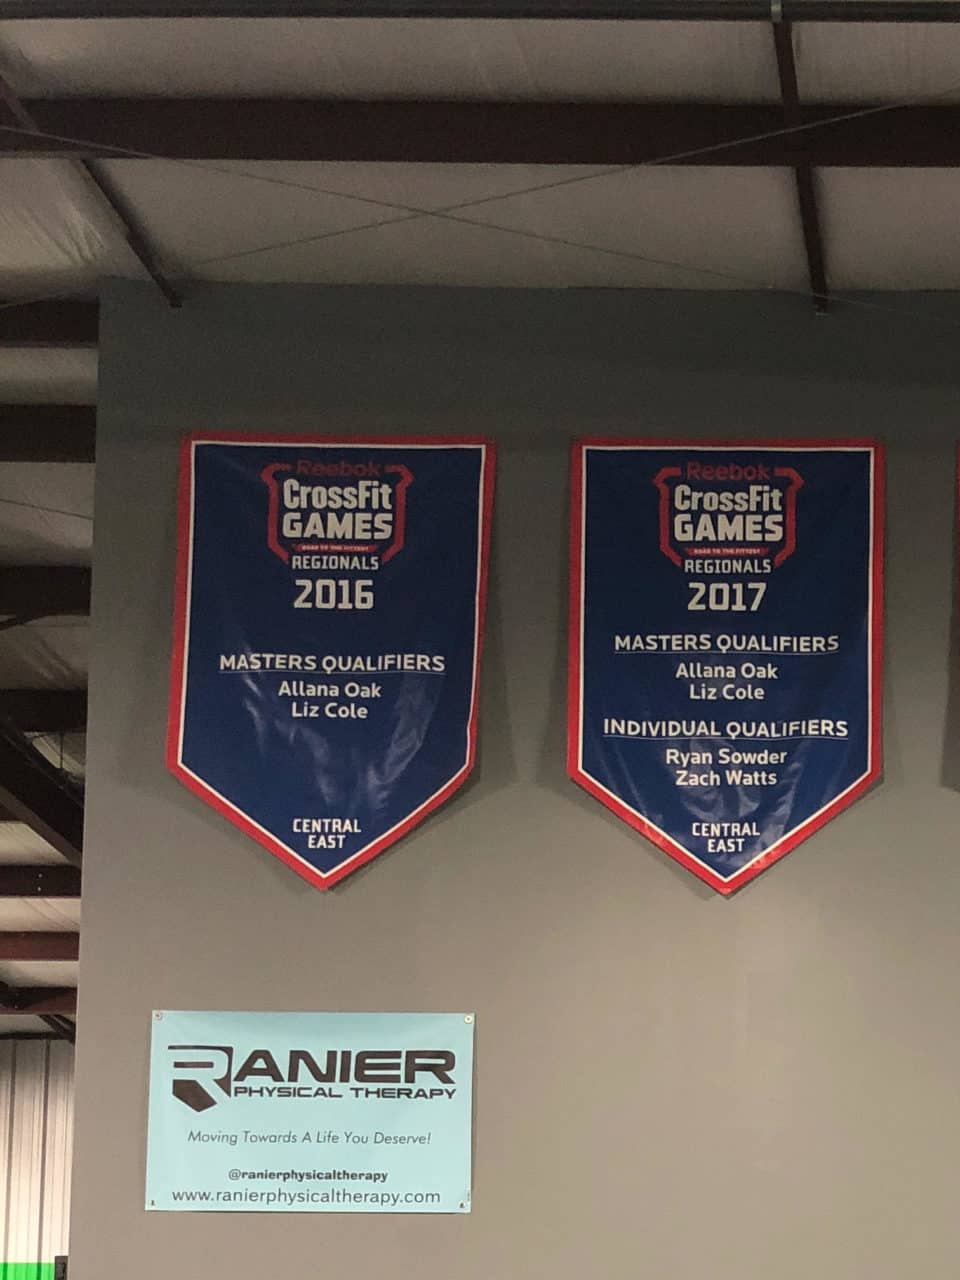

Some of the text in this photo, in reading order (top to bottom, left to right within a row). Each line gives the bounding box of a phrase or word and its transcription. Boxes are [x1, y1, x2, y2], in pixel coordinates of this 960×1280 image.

[296, 460, 381, 476] Reebok
[687, 462, 771, 480] Reebok
[283, 479, 392, 509] CrossFit
[674, 484, 783, 511] CrossFit
[282, 512, 393, 540] GAMES
[674, 514, 783, 542] GAMES
[292, 555, 379, 570] REGIONALS
[685, 559, 771, 573] REGIONALS
[293, 579, 374, 610] 2016
[687, 582, 767, 611] 2017
[614, 634, 840, 653] MASTERS QUALIFIERS
[220, 653, 445, 673] MASTERS QUALIFIERS
[675, 663, 779, 679] Allana Oak
[278, 681, 382, 698] Allana Oak
[690, 684, 765, 700] Liz Cole
[291, 702, 368, 719] Liz Cole
[603, 718, 848, 738] INDIVIDUAL QUALIFIERS
[665, 749, 787, 767] Ryan Sowder
[675, 770, 777, 786] Zach Watts
[293, 818, 362, 834] CENTRAL
[691, 822, 761, 837] CENTRAL
[307, 834, 346, 849] EAST
[708, 838, 744, 852] EAST
[168, 1044, 456, 1113] RANIER
[234, 1086, 456, 1099] PHYSICAL THERAPY
[187, 1130, 431, 1145] Moving Towards A Life You Deserve!
[228, 1169, 388, 1183] @ranierphysicaltherapy
[172, 1189, 441, 1206] www.ranierphysicaltherapy.com
